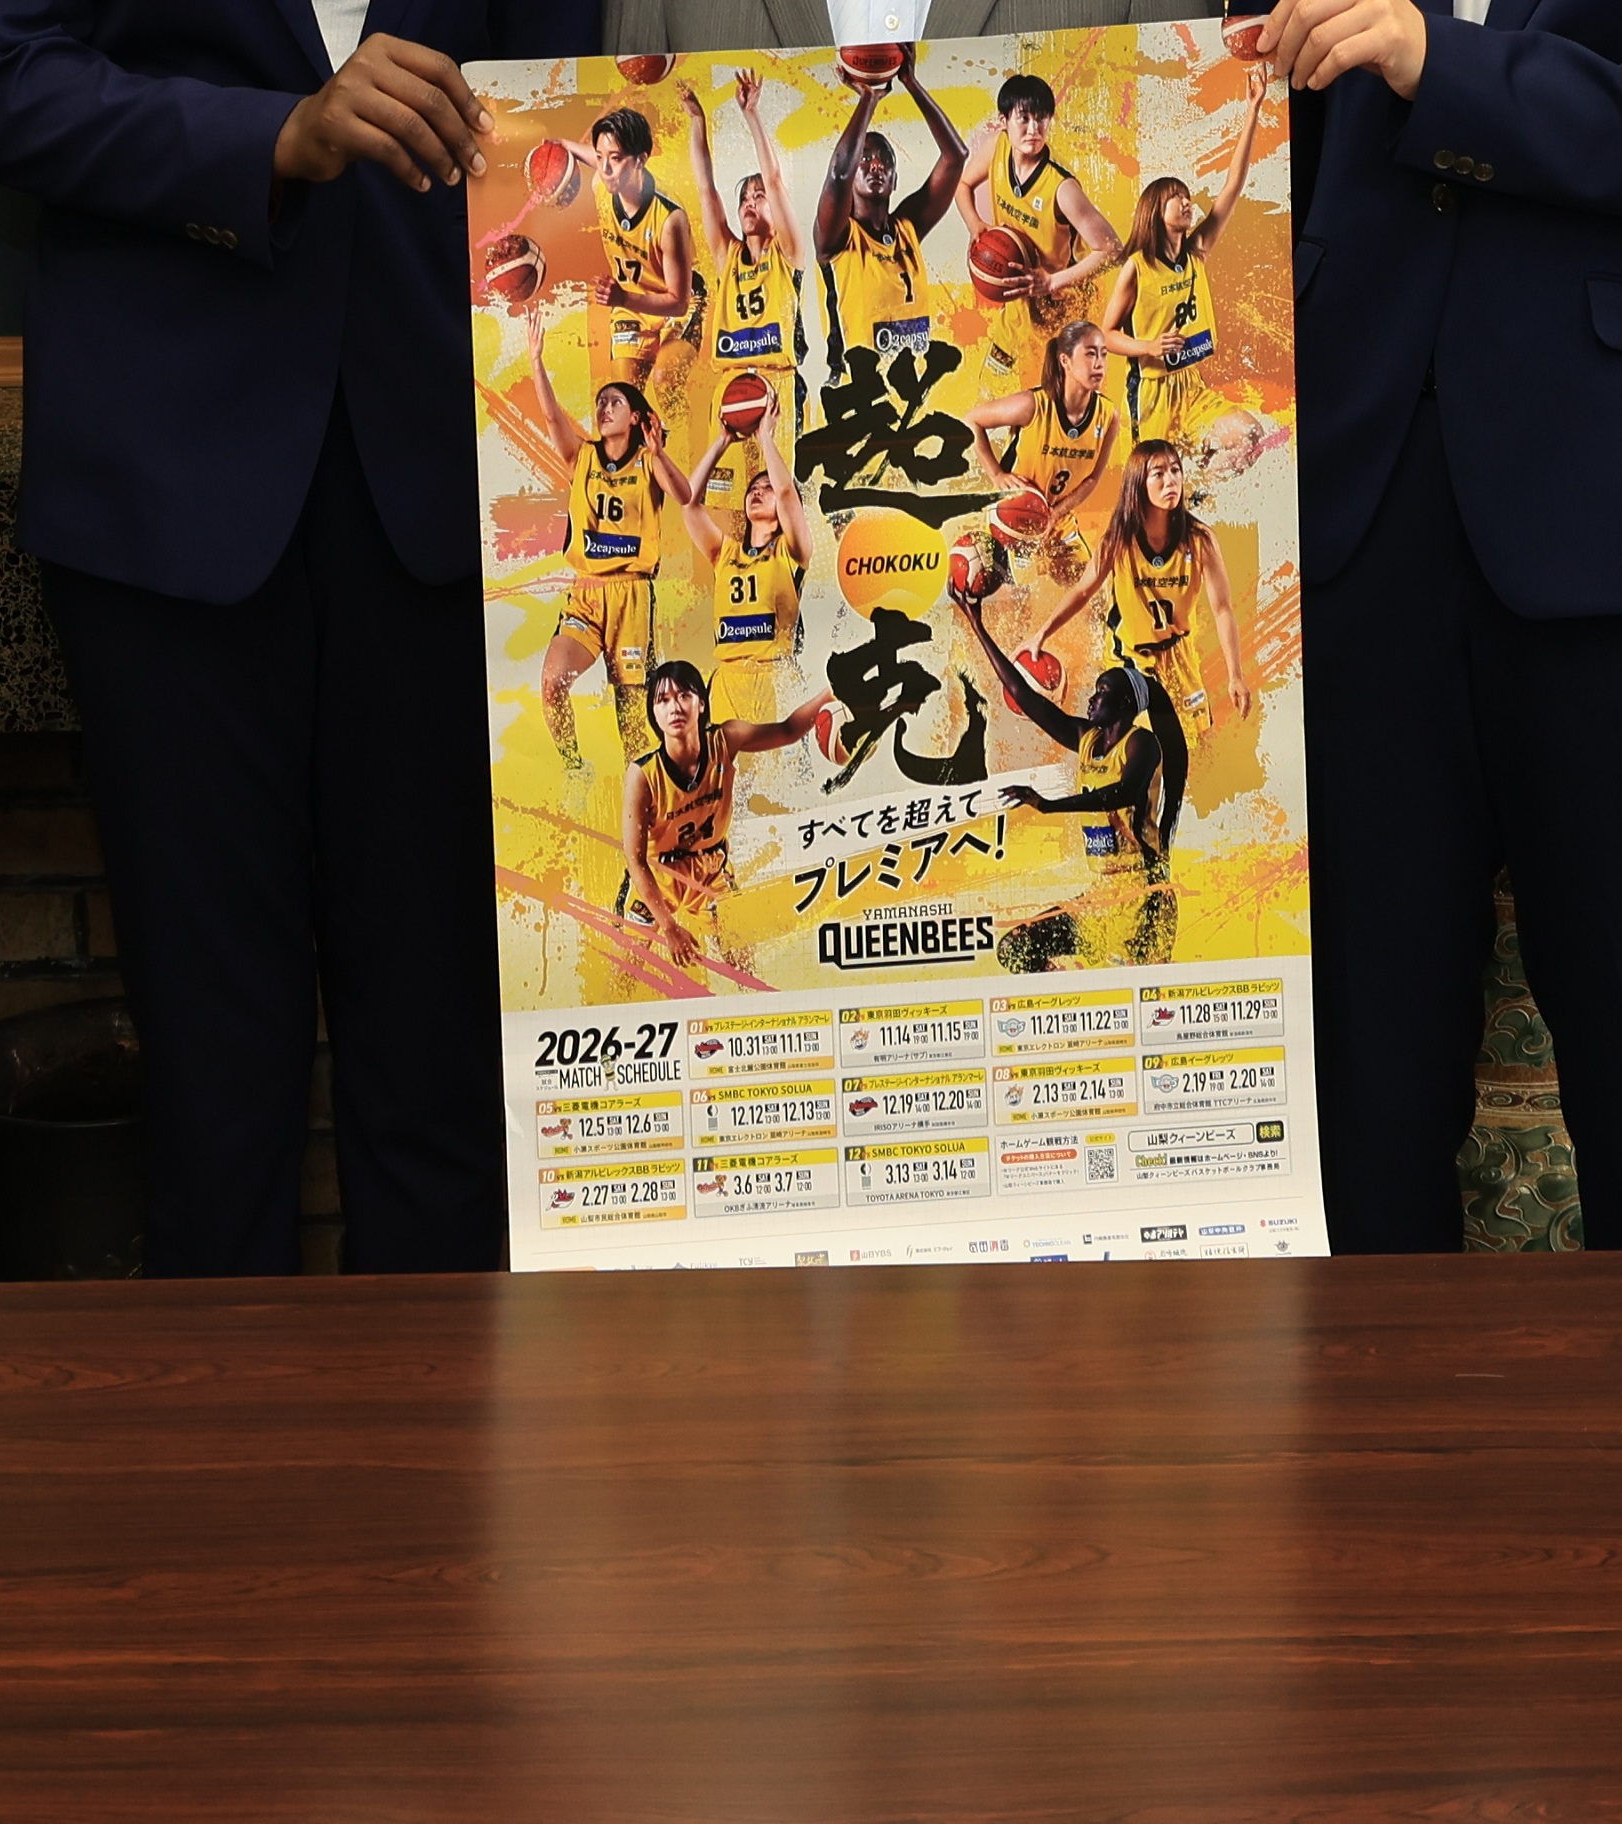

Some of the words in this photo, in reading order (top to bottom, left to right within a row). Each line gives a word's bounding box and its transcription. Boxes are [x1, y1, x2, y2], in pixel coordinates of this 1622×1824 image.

[615, 256, 642, 284] 17
[900, 271, 916, 303] 1
[736, 285, 765, 320] 45
[1049, 469, 1071, 496] 3
[595, 493, 623, 522] 16
[844, 547, 941, 578] CHOKOKU
[730, 574, 758, 604] 31
[819, 606, 989, 796] 克
[798, 790, 983, 850] すべてを超えて
[794, 814, 1006, 914] プレミアへ!
[863, 903, 953, 920] YAMANASHI
[819, 916, 994, 966] QUEENBEES
[1142, 989, 1158, 1001] 04
[1168, 984, 1250, 998] 新潟アルビレックスBB
[1251, 982, 1279, 993] ラビッツ
[842, 1011, 857, 1022] 02
[867, 1005, 948, 1020] 東京羽田ヴィッキーズ
[992, 1000, 1007, 1012] 03
[1018, 996, 1081, 1009] 広島イーグレッツ
[1180, 1004, 1210, 1024] 11.28
[1231, 1000, 1261, 1021] 11.29
[690, 1022, 704, 1033] 01
[880, 1025, 910, 1046] 11.14
[931, 1022, 961, 1043] 11.15
[1031, 1014, 1060, 1035] 11.21
[1080, 1010, 1111, 1031] 11.22
[535, 1022, 679, 1067] 2026-27
[728, 1036, 760, 1057] 10.31
[780, 1033, 802, 1053] 11.1
[1017, 1041, 1066, 1052] 東京エレクトロン
[995, 1069, 1011, 1080] 08
[1020, 1063, 1101, 1077] 東京羽田ヴィッキーズ
[1144, 1057, 1160, 1069] 09
[1171, 1053, 1234, 1067] 広島イーグレッツ
[560, 1066, 601, 1089] MATCH
[617, 1060, 681, 1085] SCHEDULE
[844, 1080, 860, 1091] 07
[1183, 1072, 1207, 1093] 2.19
[1230, 1068, 1257, 1089] 2.20
[693, 1092, 708, 1103] 06
[719, 1088, 745, 1100] SMBC
[748, 1086, 779, 1097] TOKYO
[781, 1083, 812, 1095] SOLUA
[883, 1093, 913, 1115] 12.19
[933, 1090, 964, 1111] 12.20
[1033, 1083, 1059, 1104] 2.13
[1080, 1079, 1106, 1100] 2.14
[539, 1103, 553, 1114] 05
[563, 1098, 641, 1112] 三菱電機コアラーズ
[731, 1104, 764, 1126] 12.12
[783, 1101, 814, 1122] 12.13
[579, 1117, 605, 1137] 12.5
[626, 1114, 651, 1134] 12.6
[1148, 1129, 1236, 1146] 山梨クィーンビーズ
[1259, 1125, 1281, 1138] 検索
[848, 1148, 862, 1160] 12
[872, 1146, 899, 1158] SMBC
[901, 1144, 932, 1155] TOKYO
[934, 1142, 965, 1153] SOLUA
[1000, 1135, 1079, 1149] ホームゲーム観戦方法
[542, 1170, 555, 1182] 10
[566, 1165, 650, 1180] 新潟アルビレックスBB
[651, 1162, 680, 1173] ラビッツ
[697, 1159, 709, 1171] 11
[720, 1154, 798, 1169] 三菱電機コアラーズ
[886, 1163, 910, 1184] 3.13
[933, 1159, 957, 1181] 3.14
[582, 1185, 609, 1206] 2.27
[631, 1181, 658, 1202] 2.28
[733, 1175, 753, 1195] 3.6
[775, 1171, 793, 1192] 3.7
[866, 1193, 895, 1202] TOYOTA
[895, 1191, 919, 1200] ARENA
[920, 1190, 945, 1198] TOKYO
[581, 1212, 641, 1223] 山梨市民総合体育館
